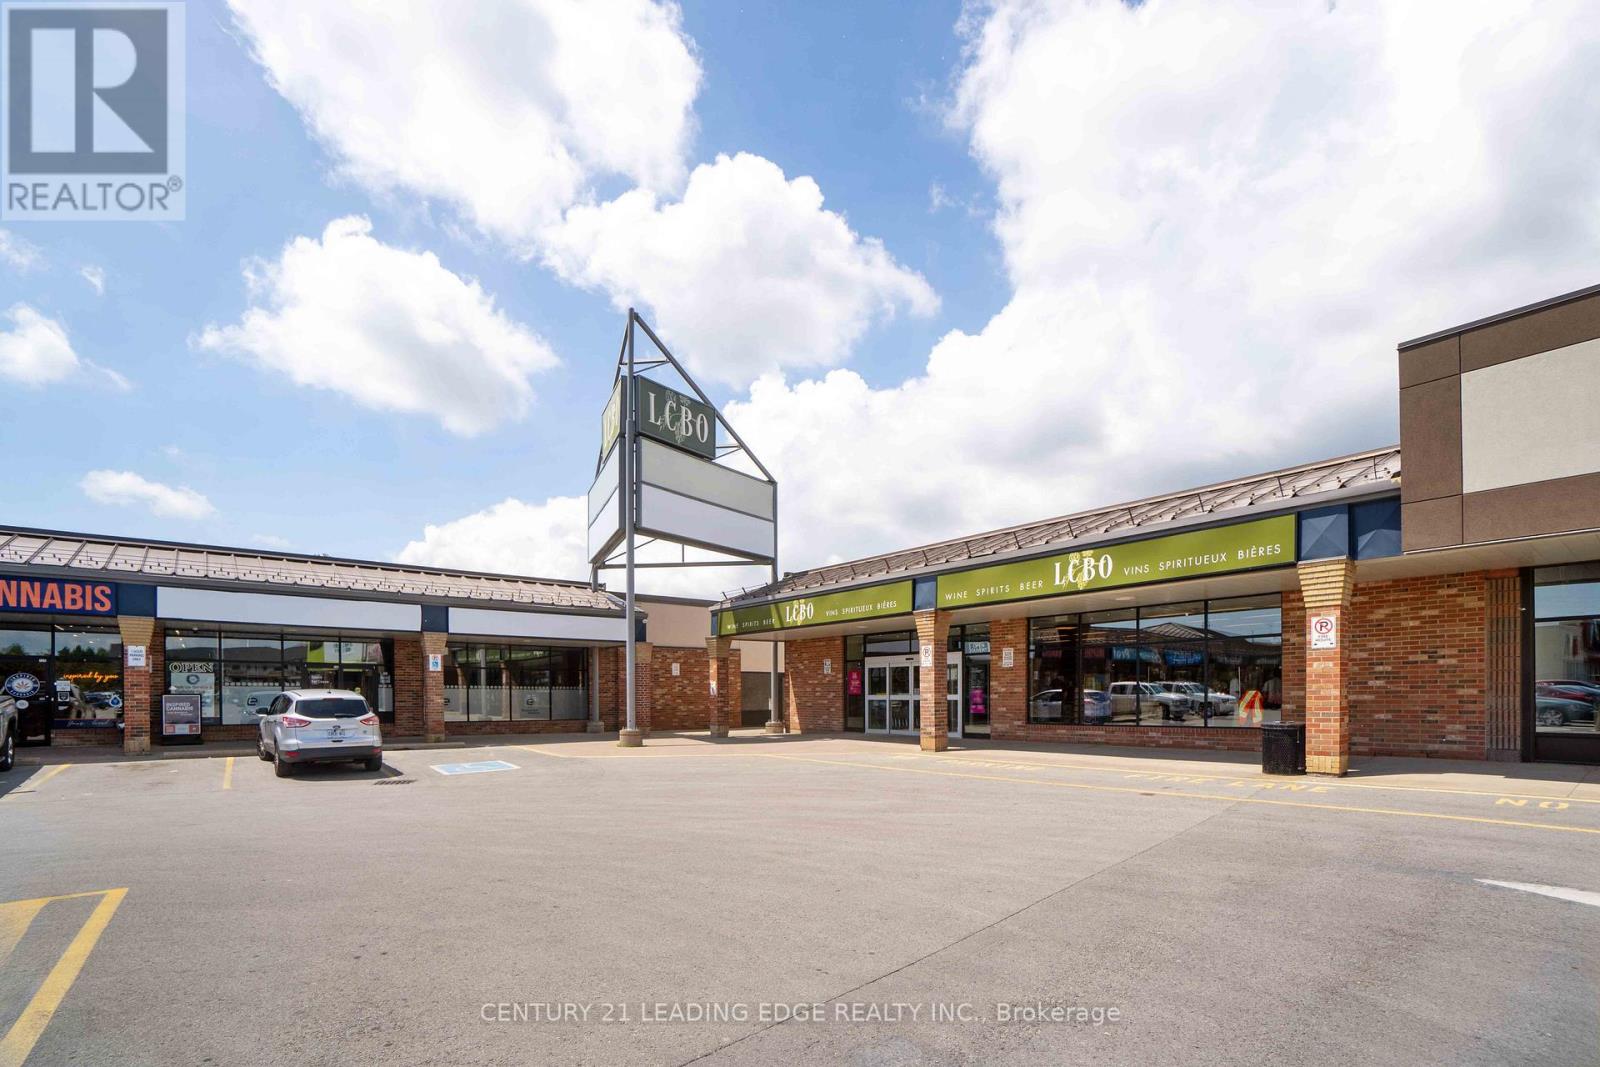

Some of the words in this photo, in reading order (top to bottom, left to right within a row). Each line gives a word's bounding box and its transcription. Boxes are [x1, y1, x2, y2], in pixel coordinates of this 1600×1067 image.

[647, 391, 710, 443] LCBO
[944, 590, 969, 601] WINE
[976, 584, 1010, 597] SPIRITS
[1019, 579, 1044, 592] BEER
[1053, 553, 1113, 587] LCBO
[1123, 564, 1150, 577] VINS
[1158, 552, 1228, 571] SPIRITUEUX
[1237, 543, 1282, 561] BIÈRES
[786, 602, 814, 622] LCBO
[169, 661, 214, 673] OPEN
[1494, 798, 1570, 811] NO
